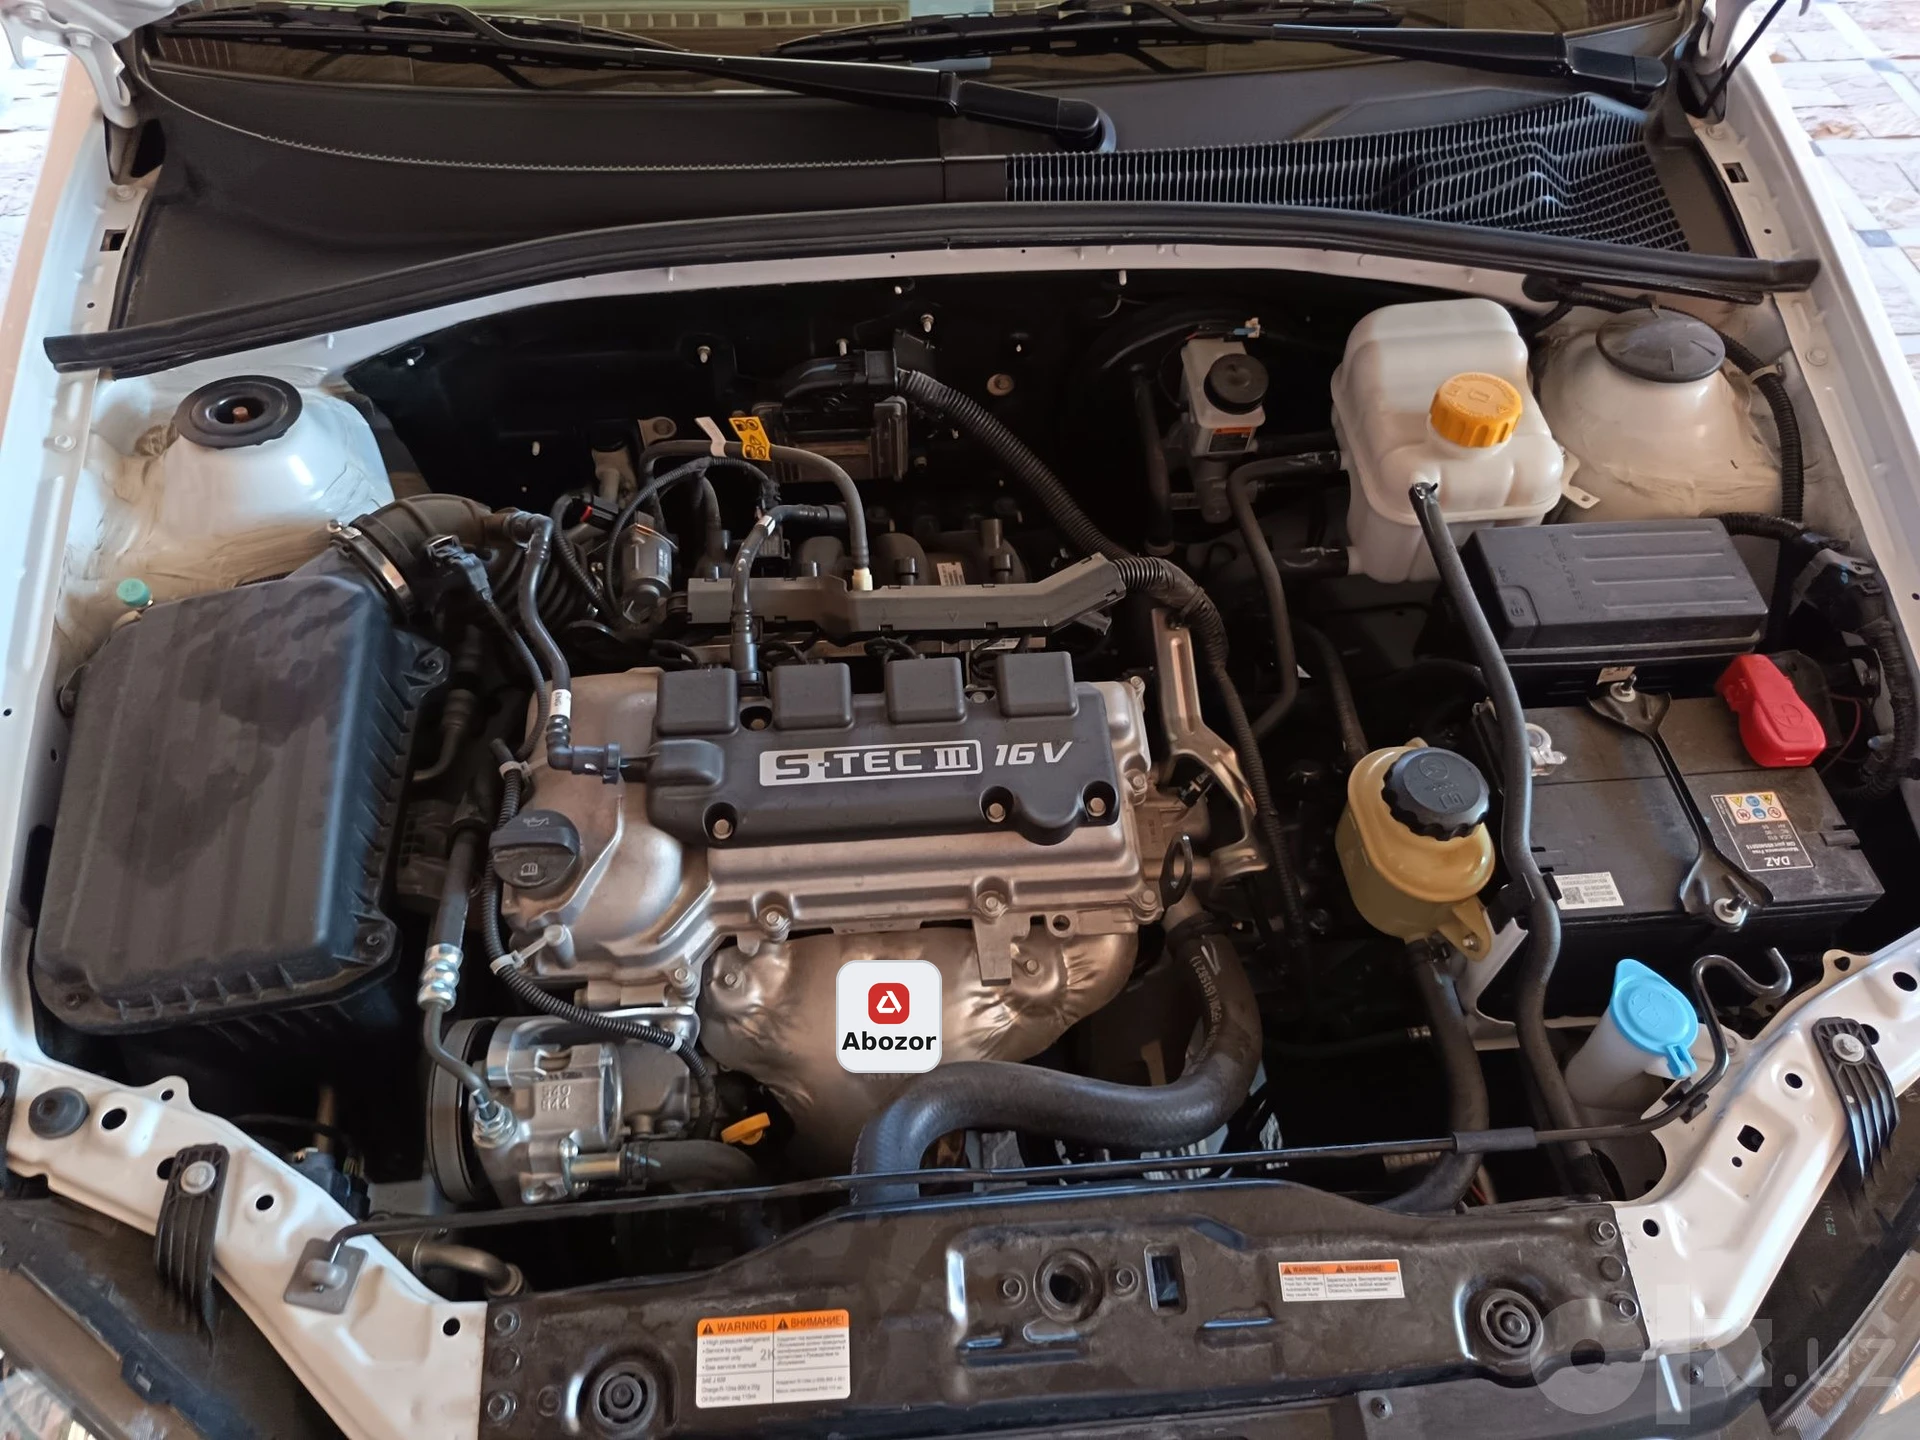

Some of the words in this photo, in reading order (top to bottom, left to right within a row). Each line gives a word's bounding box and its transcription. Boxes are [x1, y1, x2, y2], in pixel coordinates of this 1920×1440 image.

[995, 741, 1073, 766] 16V
[1764, 856, 1791, 867] DAZ
[717, 1319, 767, 1333] WARNING
[790, 1315, 844, 1328] ВНИМАНИЕ!
